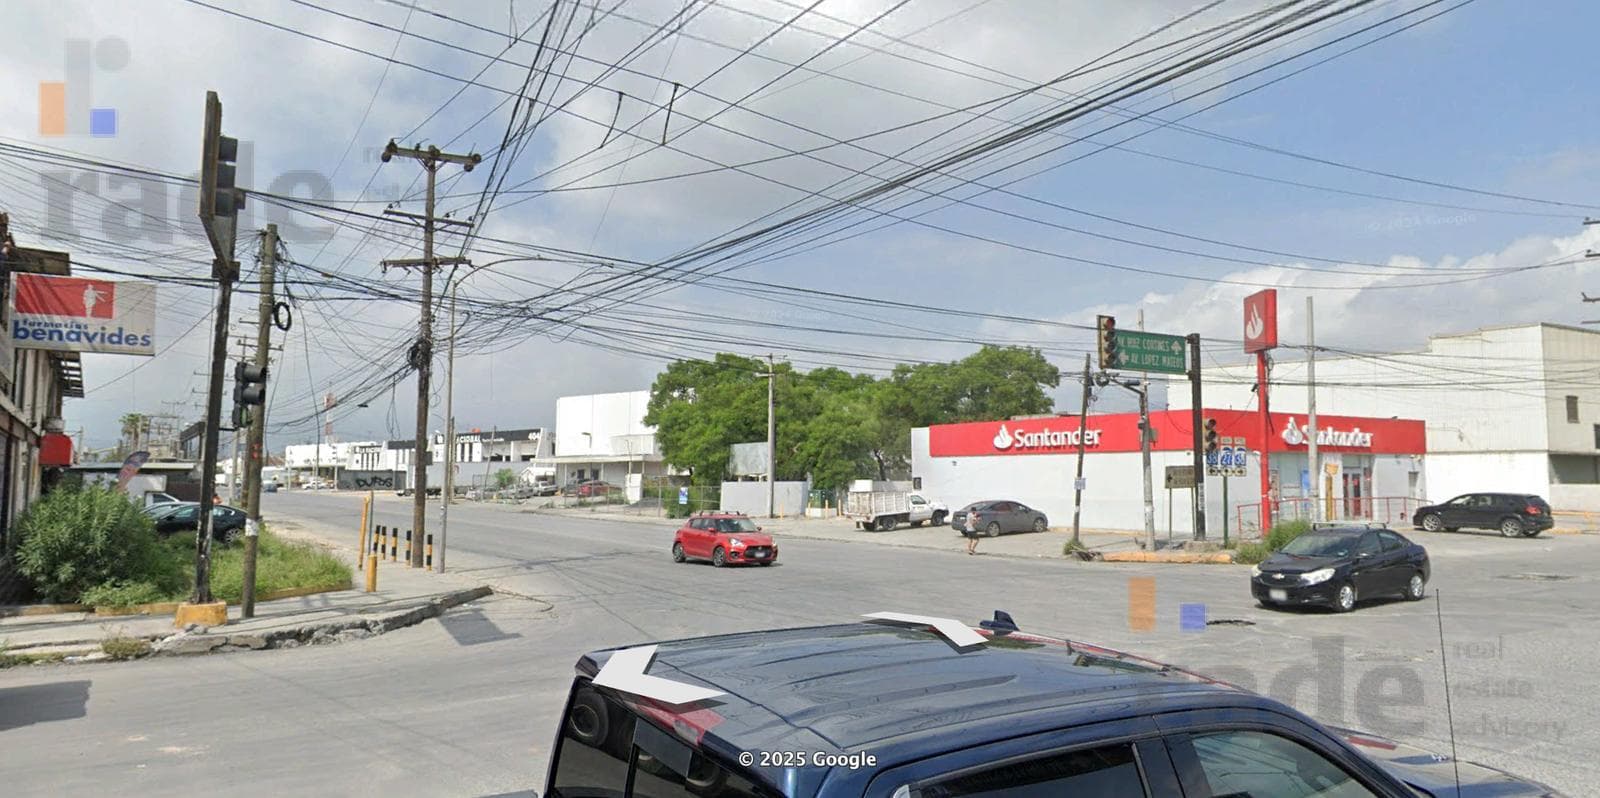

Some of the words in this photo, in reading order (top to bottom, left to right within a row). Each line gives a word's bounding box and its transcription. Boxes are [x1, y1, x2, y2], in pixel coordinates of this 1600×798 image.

[12, 319, 152, 347] benavides
[23, 318, 89, 330] farmacias
[1142, 353, 1160, 366] LOPEZ
[1014, 425, 1103, 448] Santander
